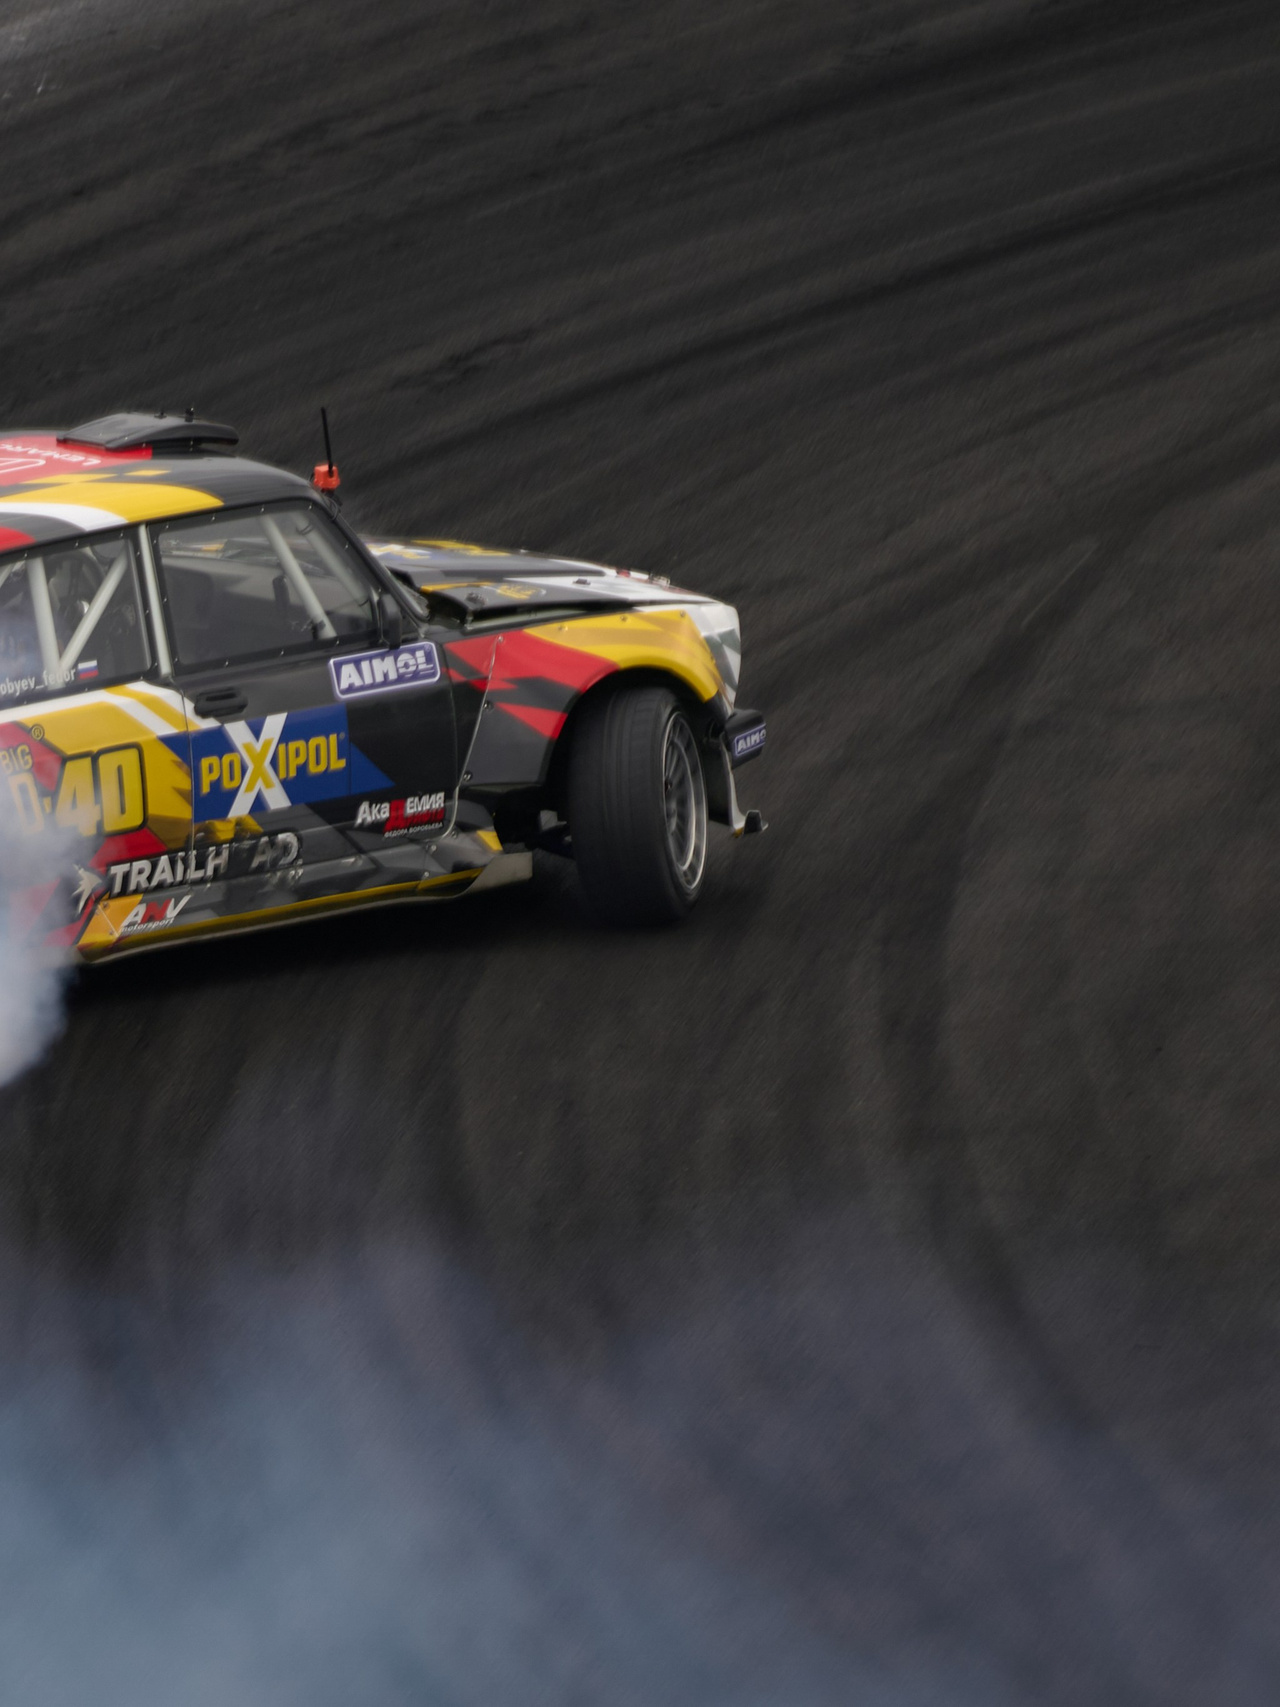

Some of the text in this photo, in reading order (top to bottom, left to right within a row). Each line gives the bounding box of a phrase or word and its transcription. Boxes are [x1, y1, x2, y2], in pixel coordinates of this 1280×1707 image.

[340, 650, 434, 690] AIMOL
[200, 728, 347, 800] POXIPOL
[737, 729, 767, 753] AIMO
[110, 831, 299, 894] TRAILHAD
